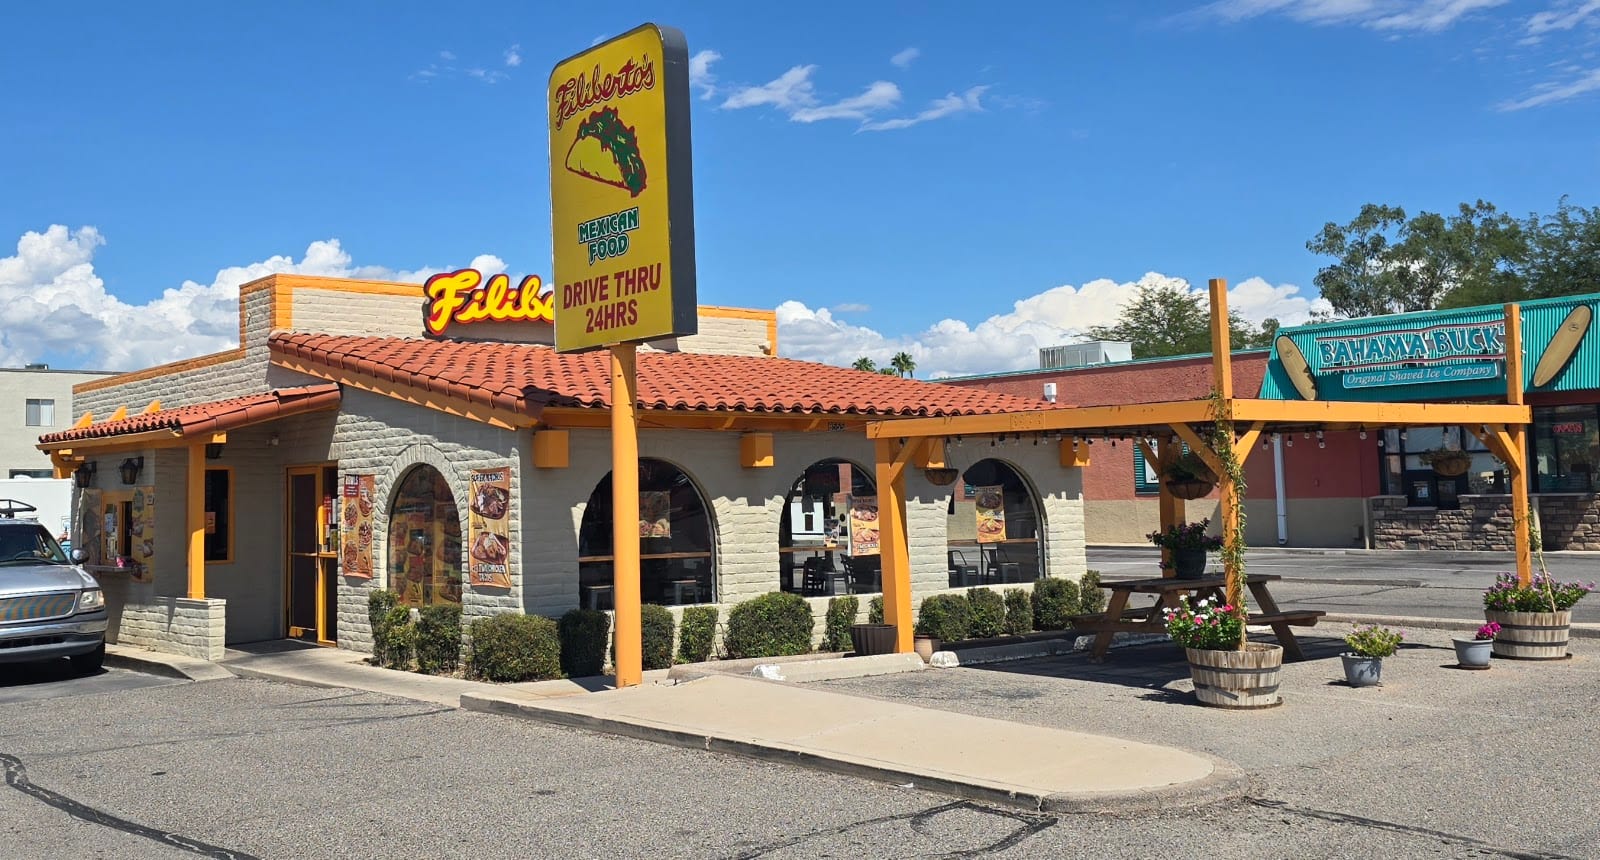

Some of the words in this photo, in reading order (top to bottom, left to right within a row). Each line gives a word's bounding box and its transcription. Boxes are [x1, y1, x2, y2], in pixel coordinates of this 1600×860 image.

[555, 52, 656, 131] Filiberto's
[578, 207, 639, 244] MEXICAN
[588, 232, 630, 266] FOOD
[563, 274, 609, 310] DRIVE
[614, 262, 661, 298] THRU
[585, 298, 638, 333] 24HRS
[1318, 333, 1430, 365] BAHAMA
[1432, 323, 1506, 355] BUCK'
[1346, 371, 1387, 386] Original
[1389, 368, 1424, 381] Shaved
[1426, 367, 1441, 379] Ice
[1443, 363, 1493, 379] Company
